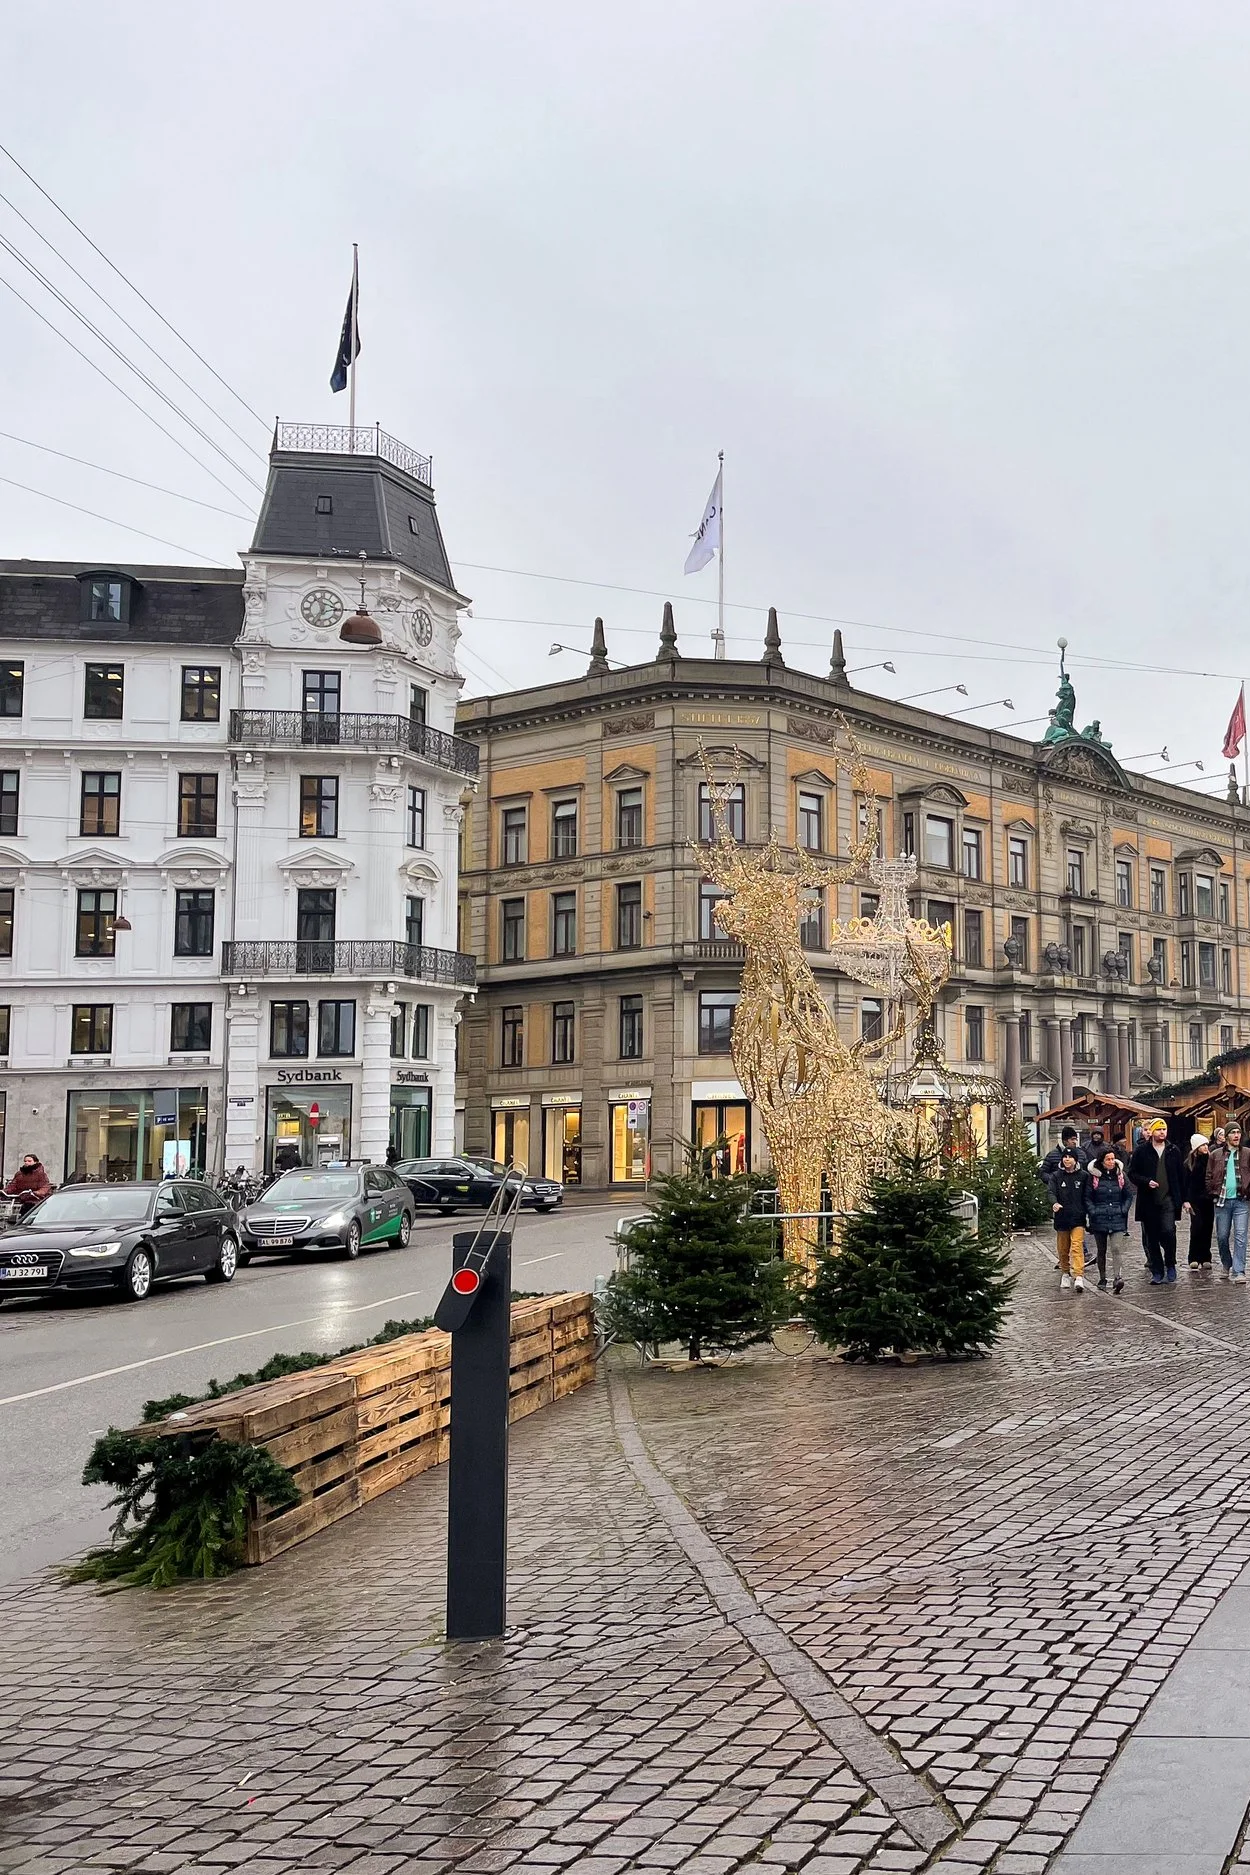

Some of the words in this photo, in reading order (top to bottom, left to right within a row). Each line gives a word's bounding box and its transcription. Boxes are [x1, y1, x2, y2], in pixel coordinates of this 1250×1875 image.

[277, 1069, 342, 1084] Sydbank
[396, 1070, 429, 1084] Sydbank
[6, 1269, 17, 1277] AJ
[19, 1268, 29, 1277] 32
[31, 1268, 44, 1276] 791
